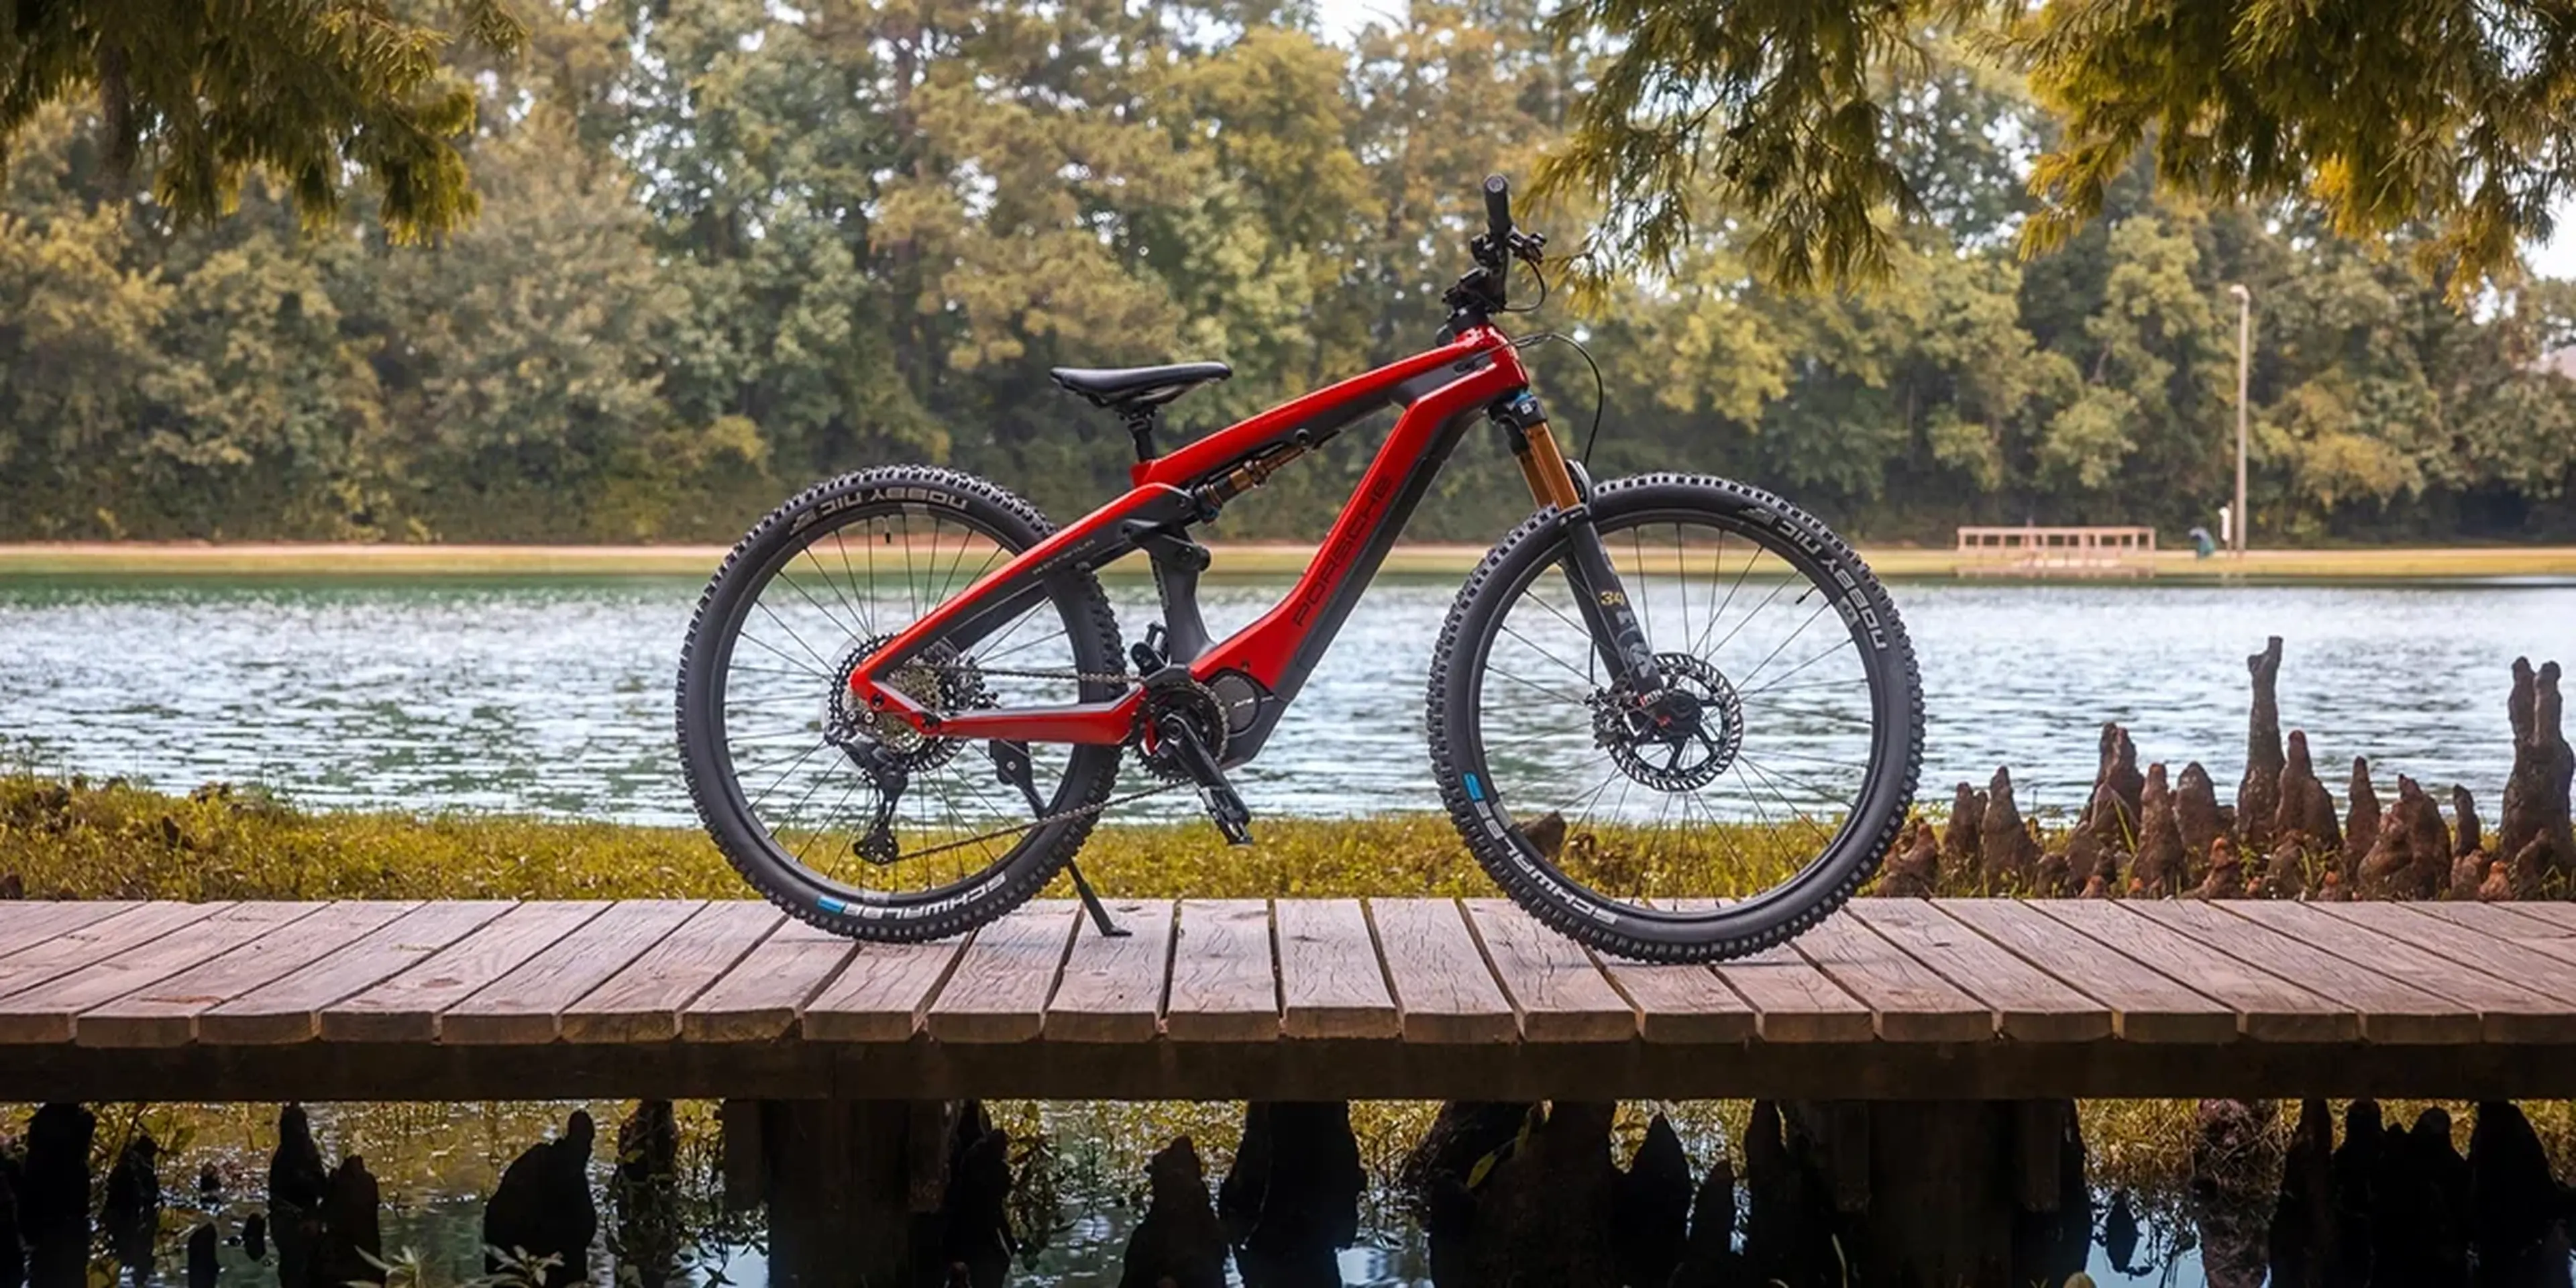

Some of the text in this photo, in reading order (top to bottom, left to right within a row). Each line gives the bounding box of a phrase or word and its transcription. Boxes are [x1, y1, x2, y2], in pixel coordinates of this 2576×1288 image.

[820, 487, 967, 515] NOBBY NIC
[1294, 476, 1391, 627] PORSCHE
[1778, 520, 1821, 554] NIC
[1601, 591, 1625, 606] 34
[1822, 559, 1886, 649] NOBBY
[1477, 802, 1617, 925] SCHWALBE
[844, 872, 1006, 919] SCHWALBE
